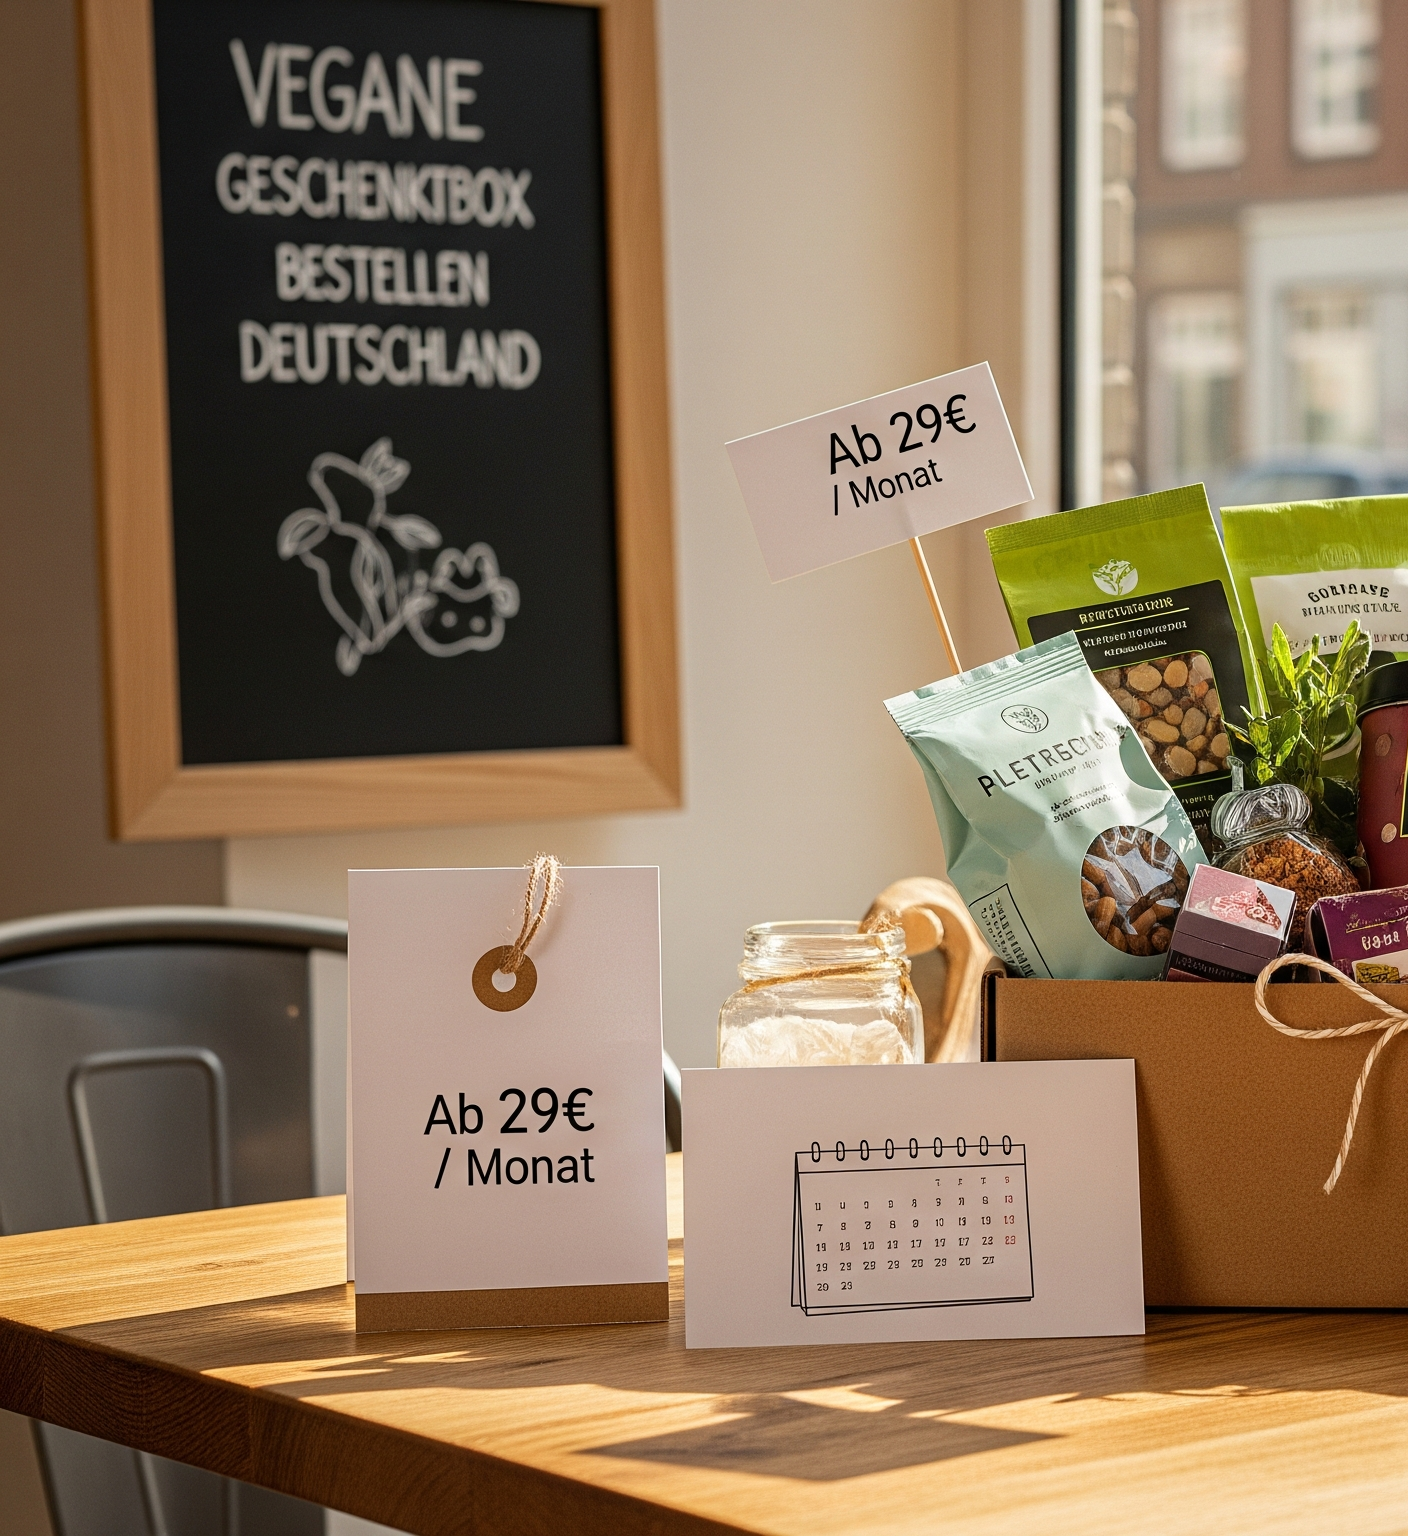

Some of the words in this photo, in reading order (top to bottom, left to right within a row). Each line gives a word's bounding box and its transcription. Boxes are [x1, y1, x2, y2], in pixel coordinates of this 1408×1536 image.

[229, 38, 485, 142] VEGANE
[275, 242, 490, 307] BESTELLEN
[238, 319, 542, 390] DEUTSCHLAND
[830, 424, 882, 475] Ab
[889, 393, 977, 454] 29€
[848, 458, 943, 508] Monat
[423, 1093, 484, 1136] Ab
[498, 1087, 595, 1134] 29€
[433, 1147, 452, 1190] /
[467, 1147, 596, 1187] Monat
